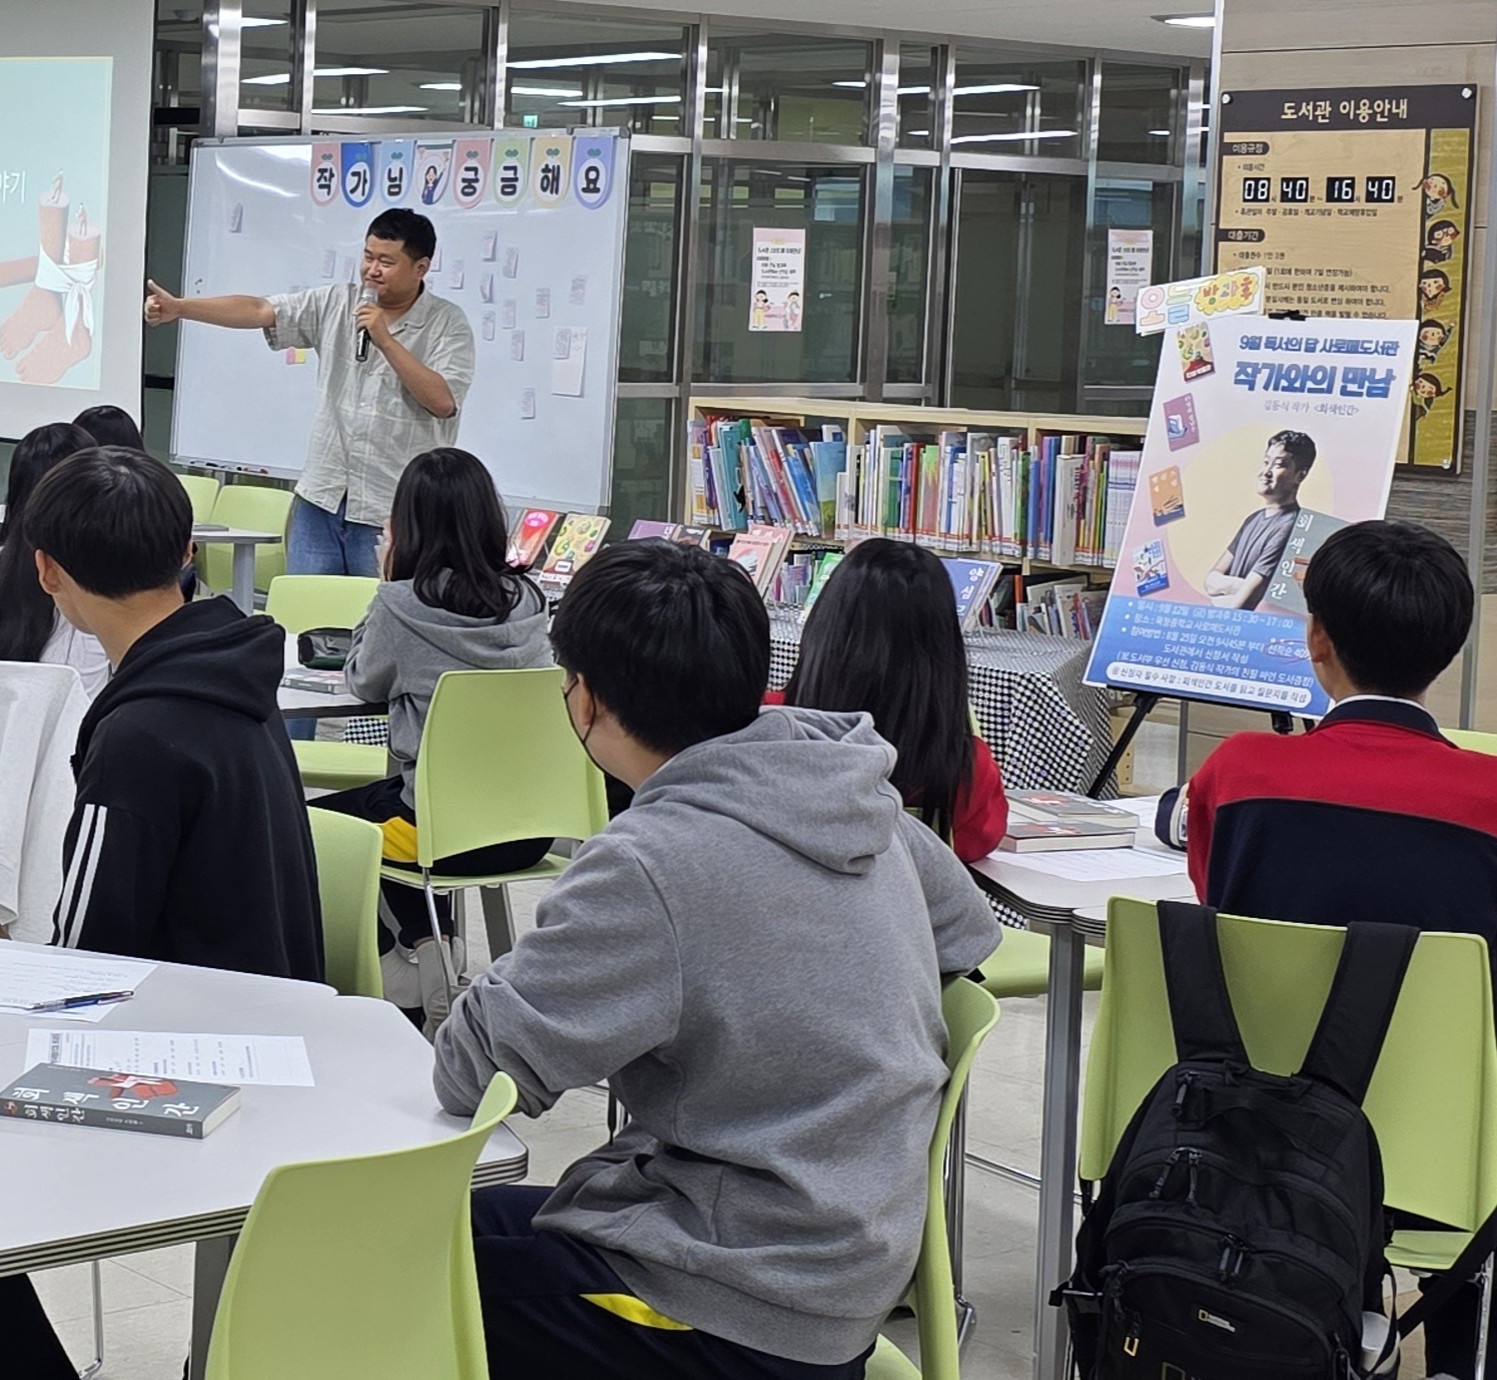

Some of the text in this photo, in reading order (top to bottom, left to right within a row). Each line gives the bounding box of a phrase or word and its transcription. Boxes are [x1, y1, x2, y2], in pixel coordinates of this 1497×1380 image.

[1280, 98, 1409, 124] 도서관 이용안내
[1232, 142, 1264, 154] 이용규정
[315, 163, 602, 197] 작가님 궁금해요
[1244, 179, 1269, 200] 08
[1282, 180, 1306, 200] 40
[1333, 179, 1353, 200] 16
[1367, 179, 1393, 200] 40
[1228, 230, 1259, 241] 대출기간
[1239, 334, 1263, 351] 9월
[1264, 335, 1302, 352] 독서의
[1304, 337, 1320, 353] 달
[1234, 360, 1337, 395] 작가와의
[1339, 365, 1397, 399] 만남
[1270, 514, 1314, 600] 회색인간
[1163, 644, 1203, 658] 도서관에서
[1205, 649, 1231, 662] 신청서
[12, 1085, 200, 1117] 회색인간
[23, 1103, 86, 1124] 회색인간
